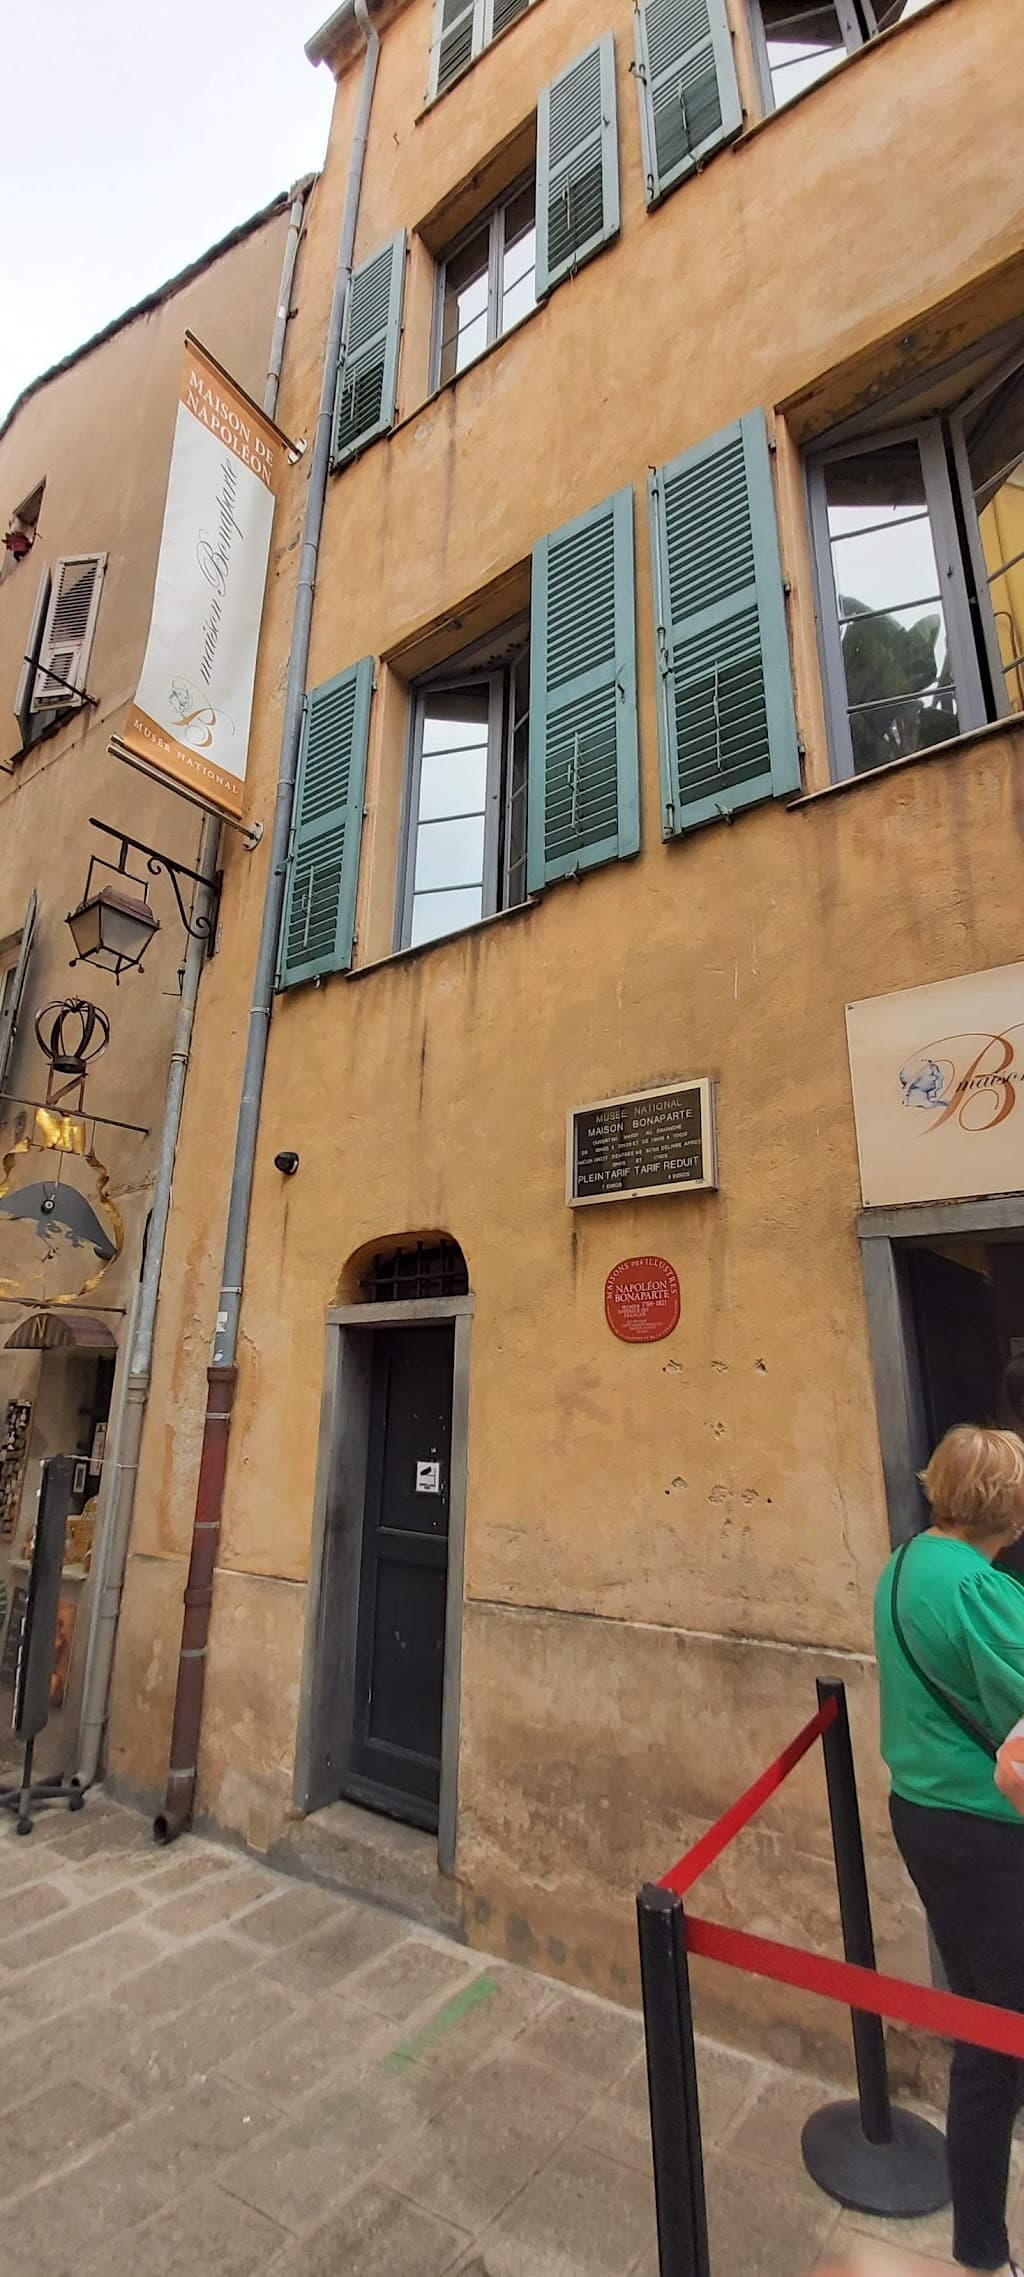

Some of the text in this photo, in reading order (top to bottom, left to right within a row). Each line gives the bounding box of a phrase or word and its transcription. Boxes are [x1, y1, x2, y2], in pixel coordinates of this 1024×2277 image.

[186, 390, 272, 486] NAPOLÉON
[190, 370, 274, 467] MAISON DE
[197, 458, 244, 685] maison Bonaparte
[176, 751, 239, 795] NATIONAL
[588, 1109, 693, 1137] MAISON BONAPARTE
[633, 1098, 682, 1115] NATIONAL
[578, 1171, 604, 1184] PLEIN
[605, 1167, 631, 1181] TARIF
[634, 1162, 661, 1175] TARIF
[663, 1156, 700, 1170] REDUIT
[606, 1262, 630, 1300] MAISONS
[645, 1258, 678, 1295] ILLUSTRES
[615, 1289, 670, 1303] BONAPARTE
